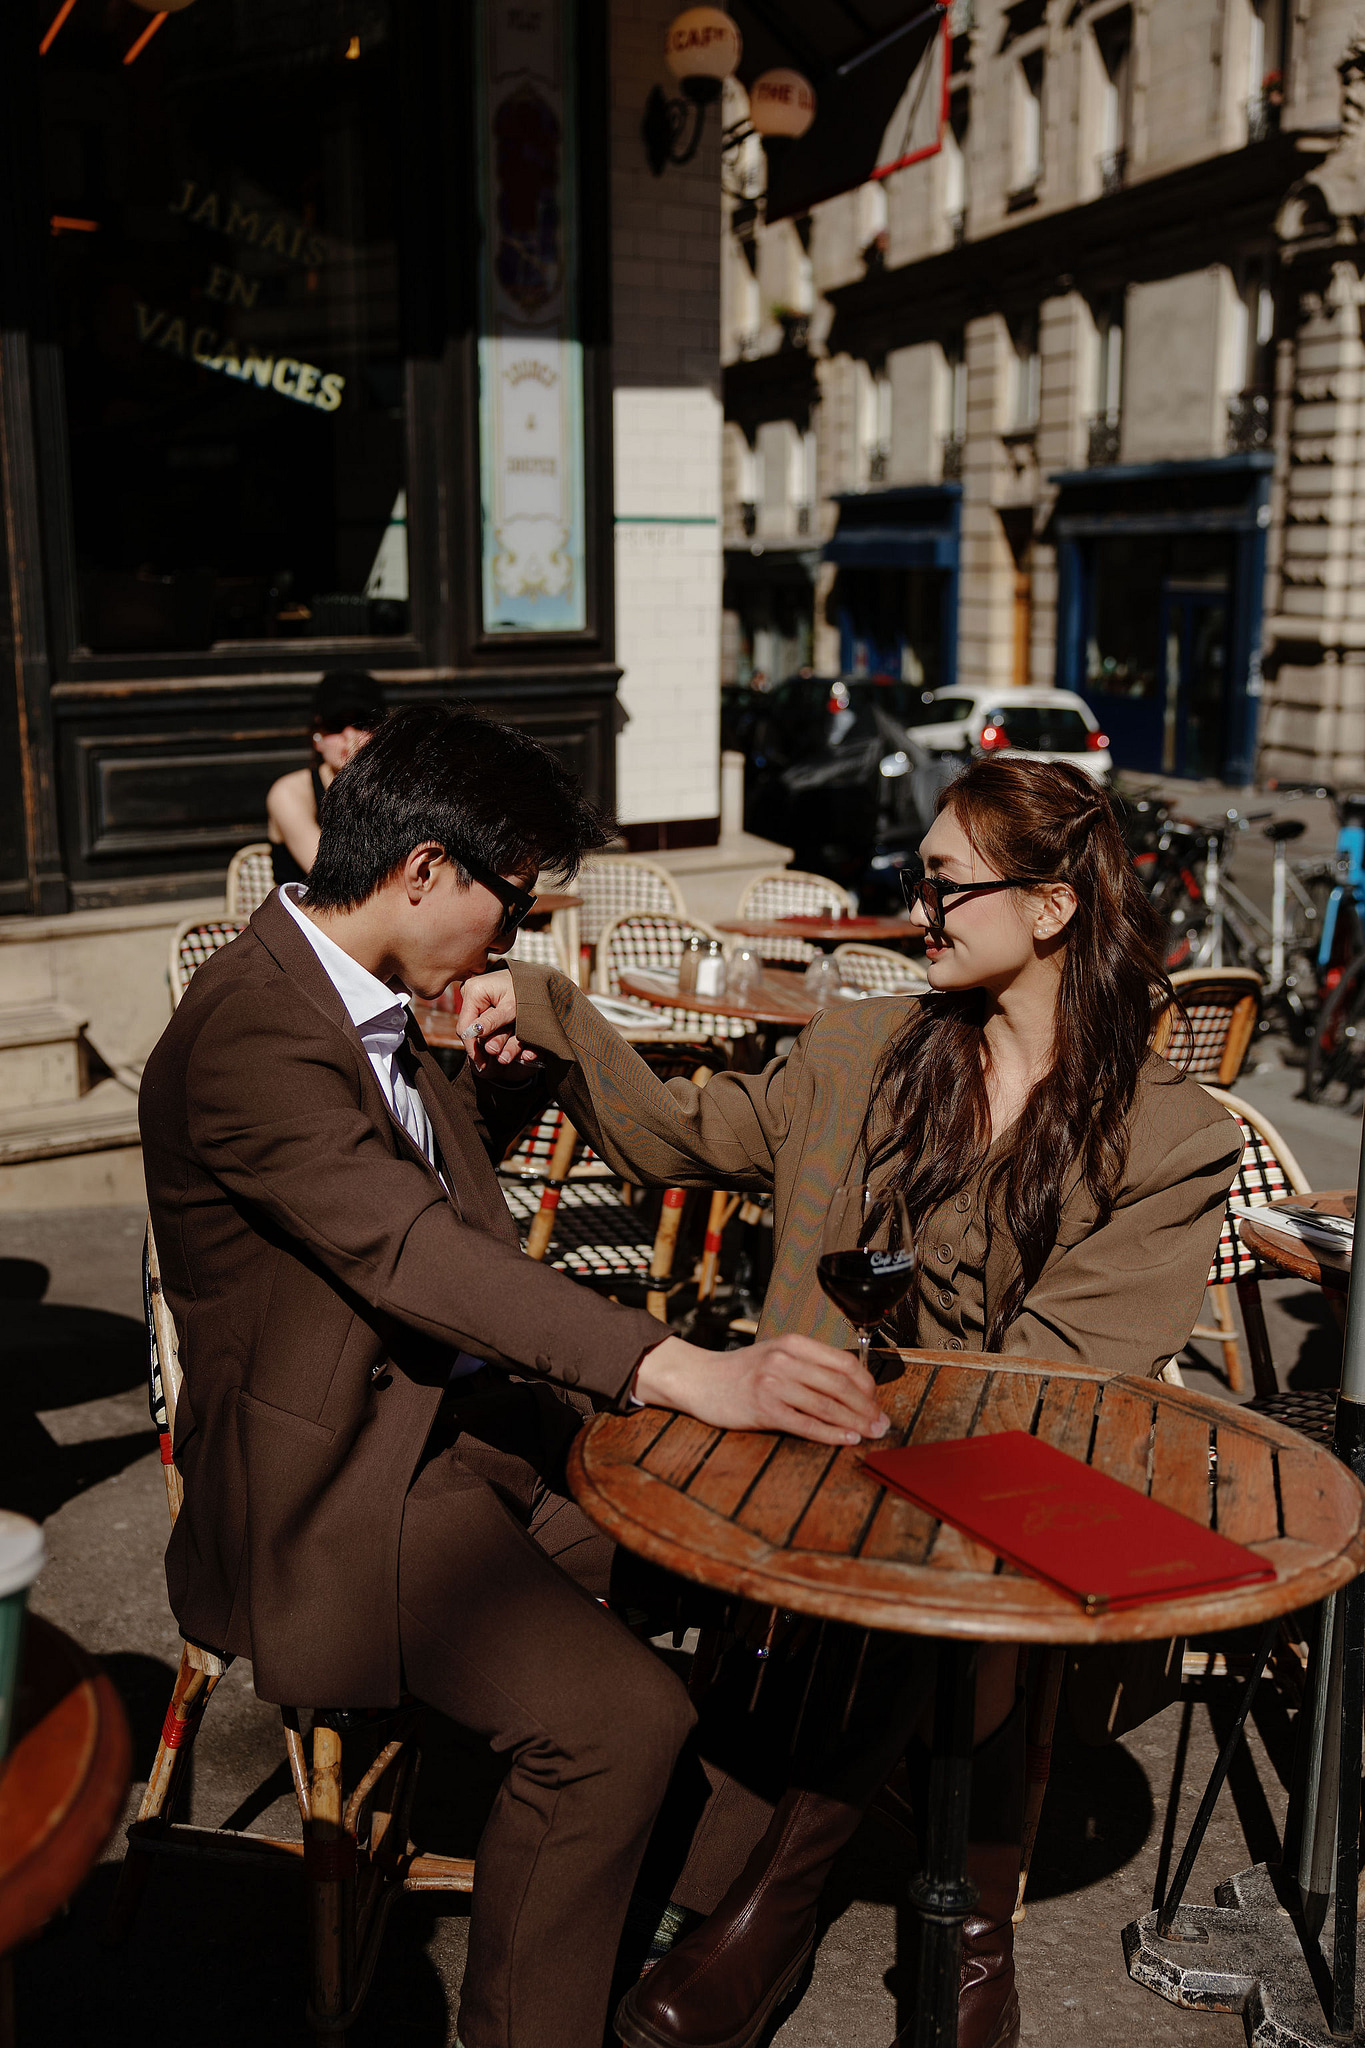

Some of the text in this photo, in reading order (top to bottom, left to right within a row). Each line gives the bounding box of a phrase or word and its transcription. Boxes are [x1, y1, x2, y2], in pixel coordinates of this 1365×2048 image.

[168, 179, 324, 266] JAMAIS
[204, 262, 260, 308] EN
[132, 301, 347, 413] VACANCES
